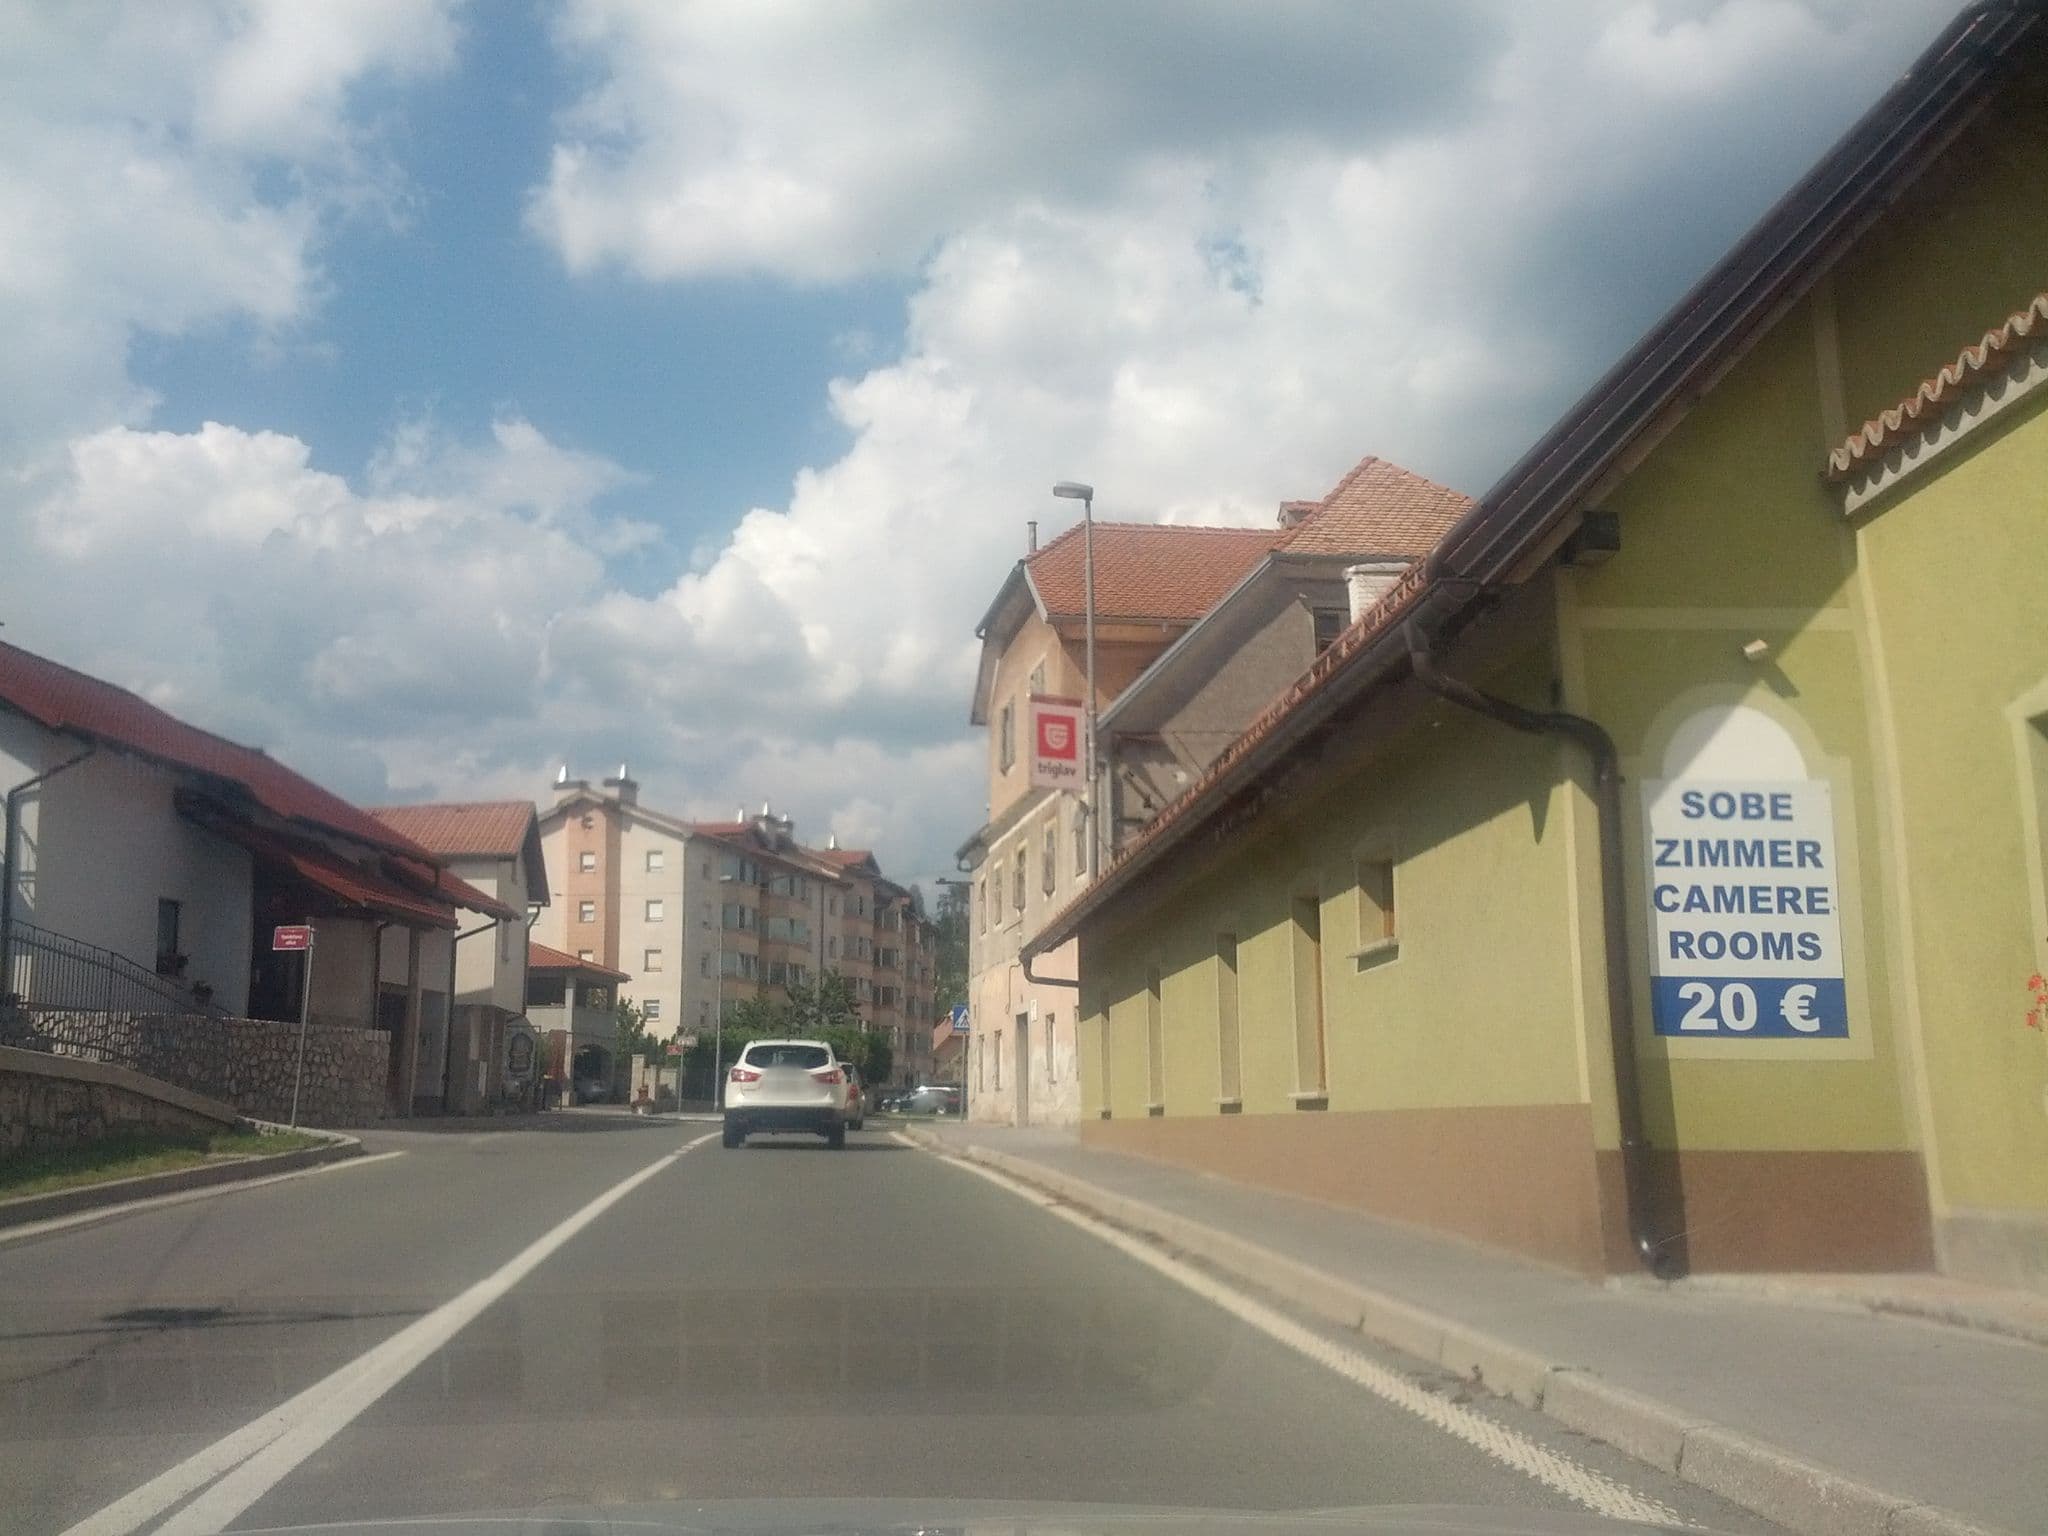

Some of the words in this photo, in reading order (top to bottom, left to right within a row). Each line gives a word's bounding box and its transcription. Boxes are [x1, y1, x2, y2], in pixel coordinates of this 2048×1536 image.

[1681, 791, 1793, 821] SOBE
[1654, 839, 1824, 868] ZIMMER
[1653, 884, 1830, 915] CAMERE
[1669, 931, 1822, 961] ROOMS
[1678, 982, 1758, 1031] 20
[1780, 984, 1820, 1032] €
